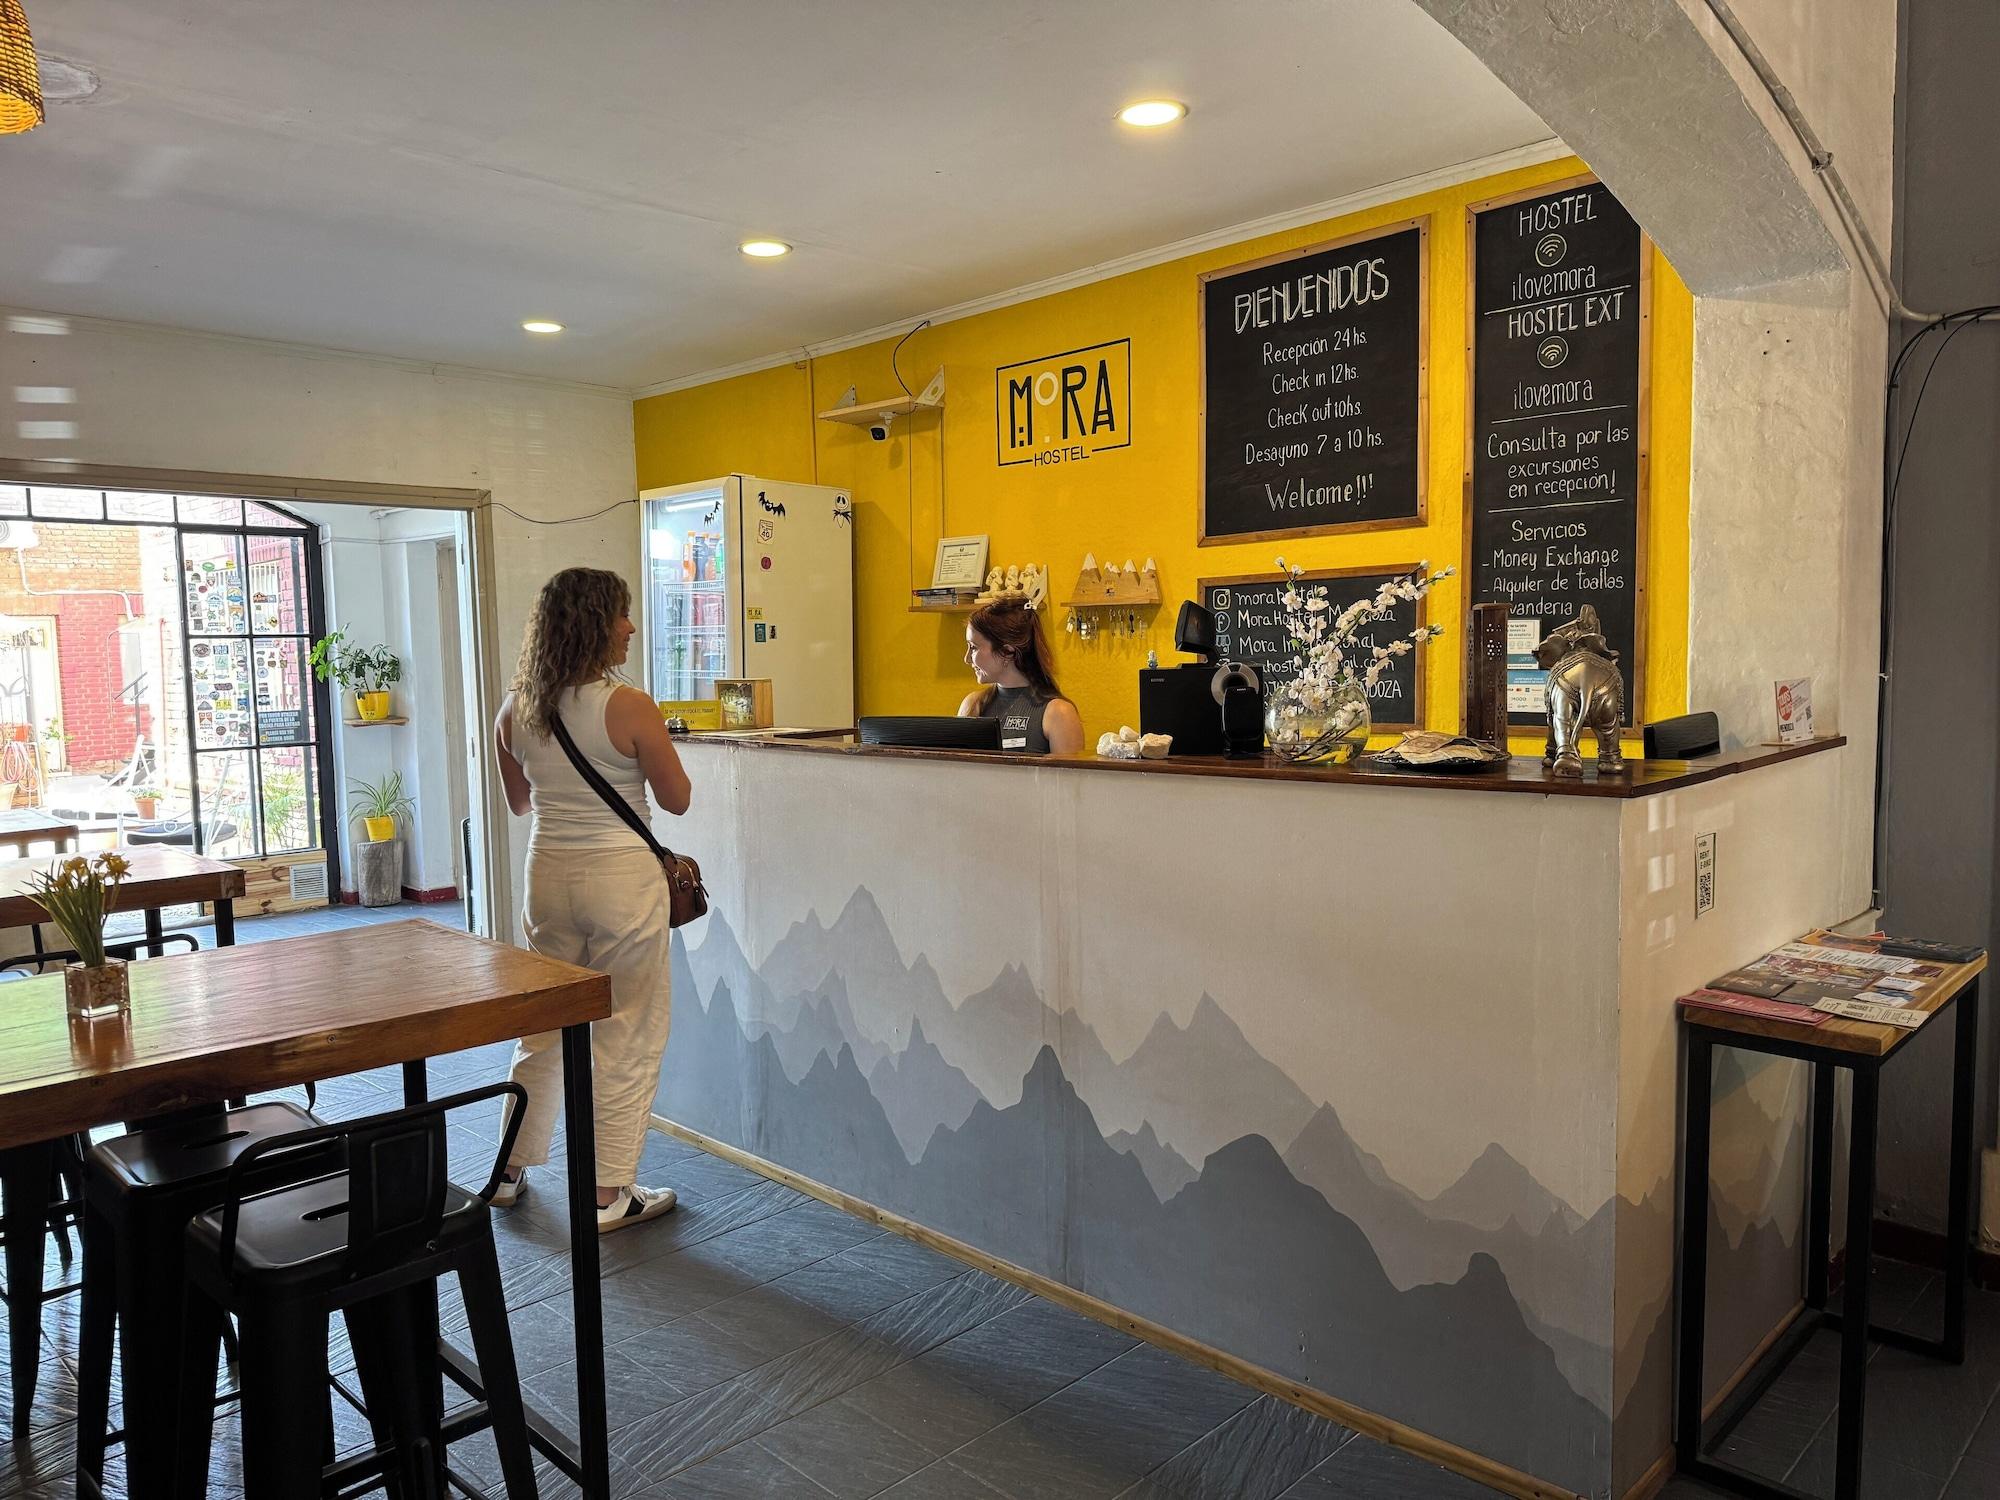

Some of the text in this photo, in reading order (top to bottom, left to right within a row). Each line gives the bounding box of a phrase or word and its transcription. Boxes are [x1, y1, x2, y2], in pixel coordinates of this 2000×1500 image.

[1519, 193, 1597, 236] HOSTEL
[1234, 257, 1389, 334] BIENVENIDOS
[1512, 265, 1597, 301] ilovemora
[1508, 292, 1624, 339] HOSTEL EXT
[1263, 337, 1328, 365] Recepción
[1333, 327, 1350, 351] 24
[1272, 368, 1310, 394] Check
[1315, 372, 1326, 386] in
[1514, 379, 1593, 410] ilovemora
[1009, 359, 1115, 448] MORA
[1312, 396, 1332, 422] out
[1245, 442, 1309, 467] Desayuno
[1317, 434, 1328, 455] 7
[1334, 437, 1342, 453] a
[1347, 428, 1363, 449] 10
[1487, 419, 1630, 459] Consulta por las
[1034, 446, 1090, 467] HOSTEL
[1508, 454, 1600, 479] excursiones
[1508, 483, 1528, 499] en
[1511, 519, 1587, 543] Servicios
[1493, 544, 1619, 571] Money Exchange
[1492, 567, 1624, 601] Alquiler de toallas
[1238, 609, 1273, 629] Mora
[1239, 635, 1278, 656] Mora
